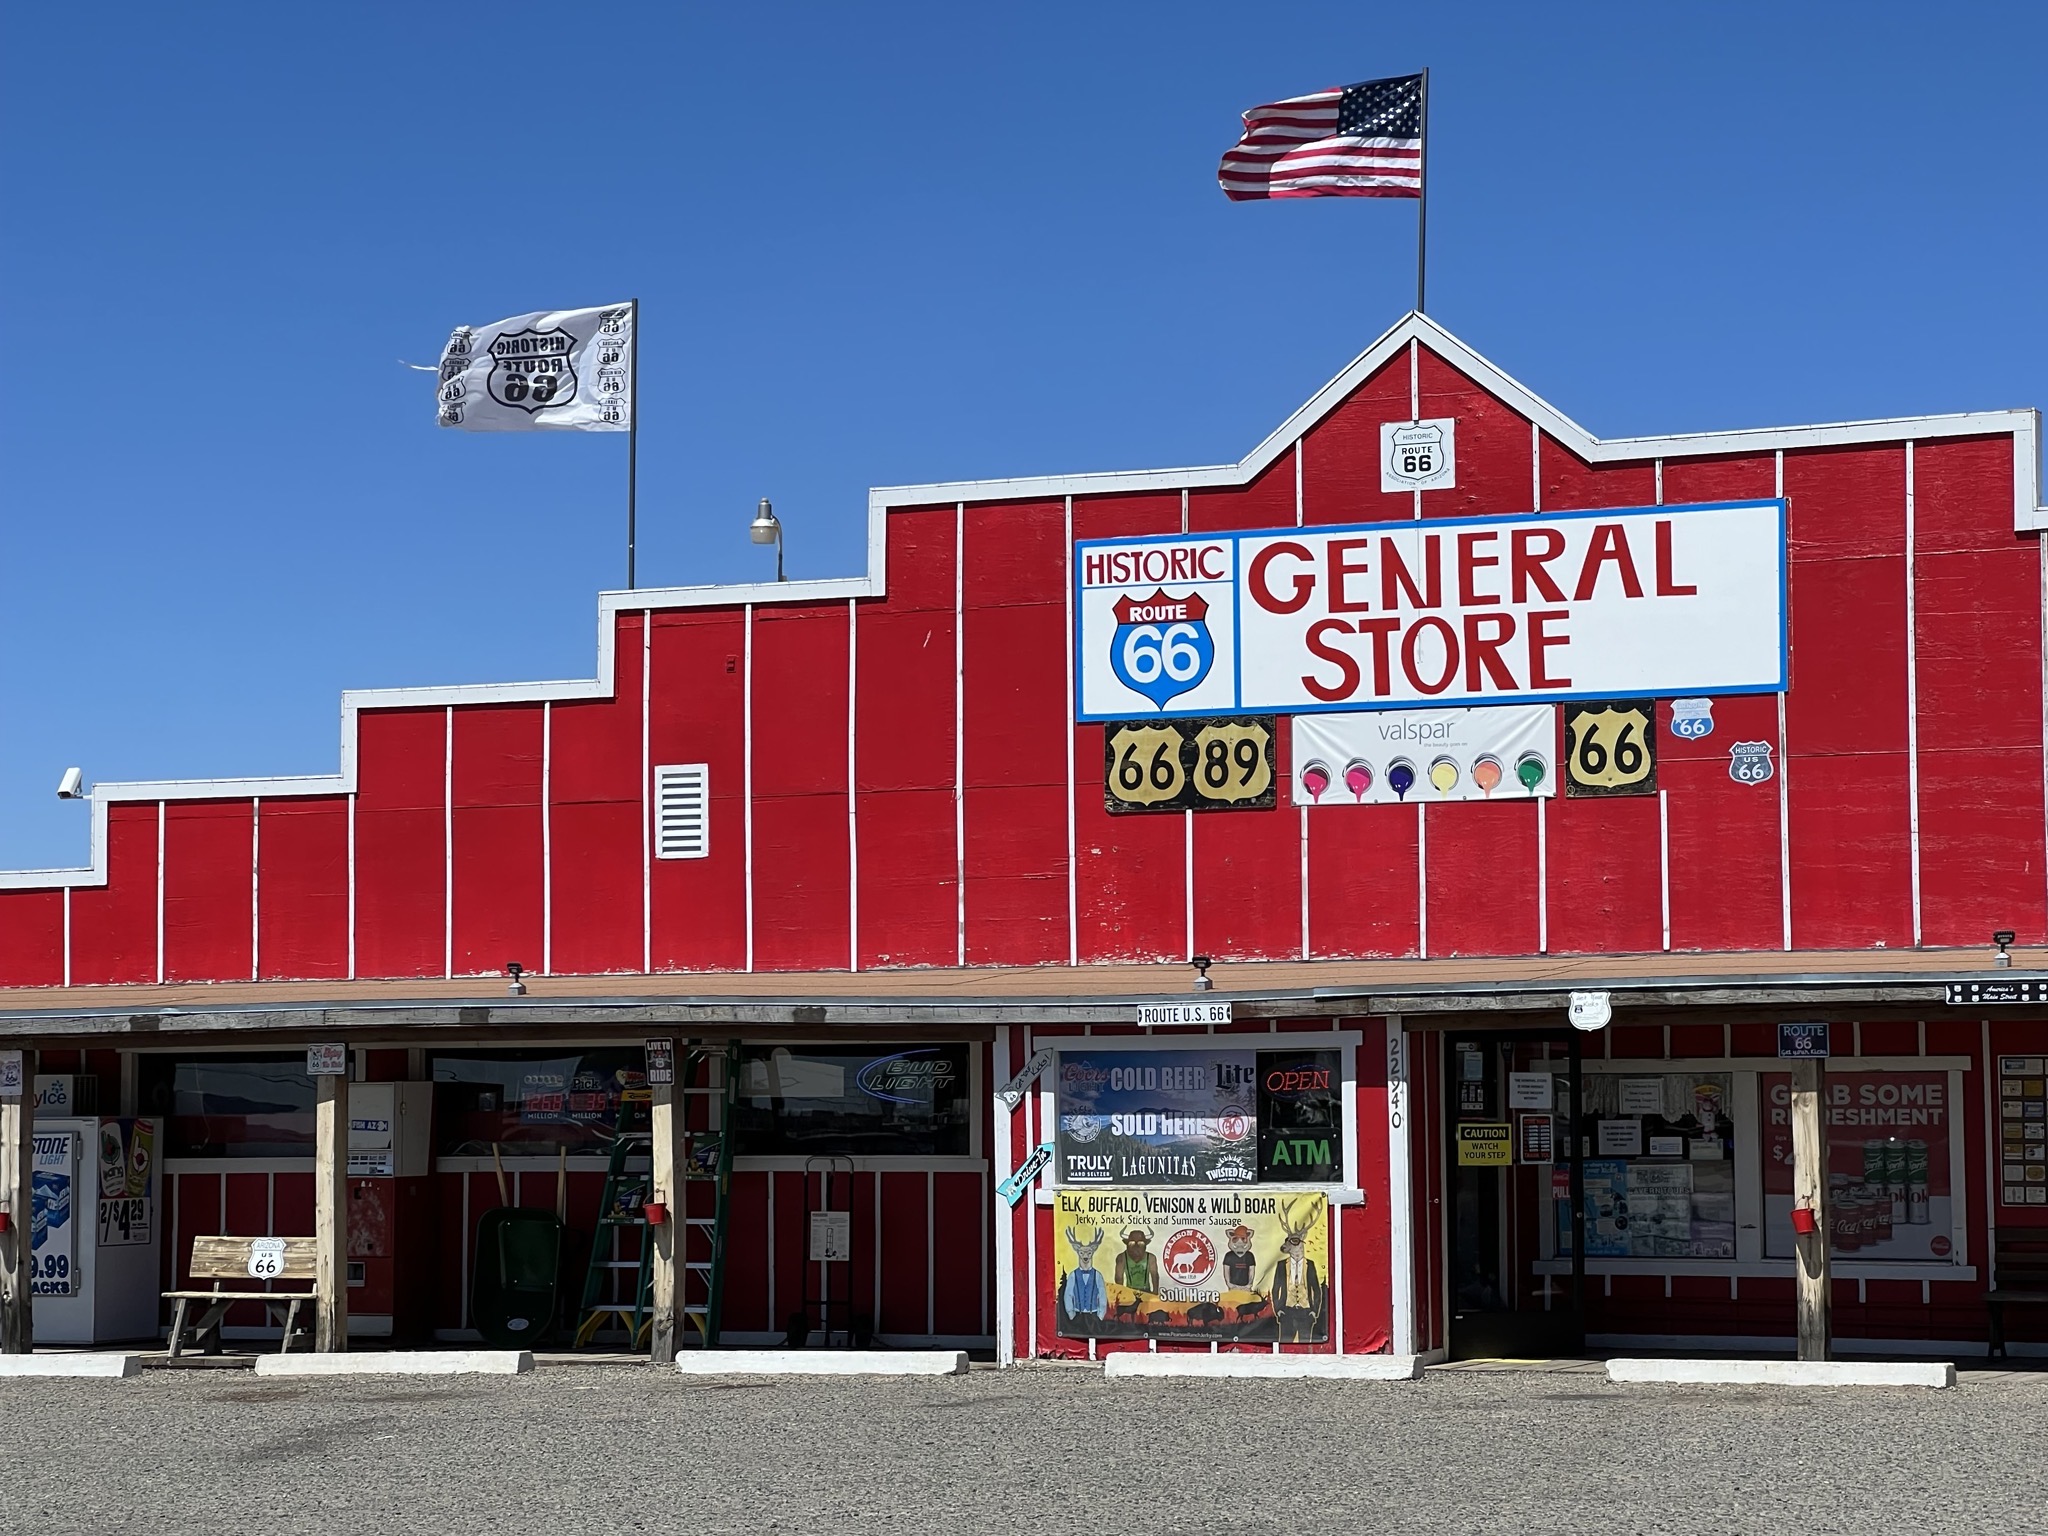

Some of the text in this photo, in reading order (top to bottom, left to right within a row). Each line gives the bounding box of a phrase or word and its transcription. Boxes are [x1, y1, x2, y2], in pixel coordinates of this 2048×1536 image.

[1402, 432, 1433, 440] HISTORIC
[1401, 446, 1433, 455] ROUTE
[1403, 455, 1432, 473] 66
[1086, 545, 1226, 585] HISTORIC
[1247, 520, 1698, 615] GENERAL
[1129, 603, 1188, 622] ROUTE
[1123, 622, 1200, 684] 66
[1300, 610, 1573, 701] STORE
[1378, 717, 1456, 745] valspar
[1680, 719, 1706, 735] 66
[1579, 722, 1643, 775] 66
[1735, 745, 1767, 754] HISTORIC
[1118, 741, 1175, 790] 66
[1204, 738, 1259, 788] 89
[1738, 763, 1765, 780] 66
[1144, 1006, 1224, 1023] ROUTE U.S. 66
[1783, 1025, 1825, 1037] ROUTE
[647, 1041, 671, 1051] LIVE TO
[1795, 1037, 1812, 1050] 66
[650, 1069, 672, 1082] RIDE
[886, 1060, 953, 1075] BUD
[1063, 1063, 1109, 1082] Coors
[571, 1079, 600, 1090] Pick
[868, 1075, 956, 1091] LIGHT
[1110, 1066, 1206, 1091] COLD BEER
[1211, 1063, 1255, 1090] Lite
[1266, 1070, 1331, 1092] OPEN
[1068, 1082, 1105, 1093] LIGHT
[1770, 1084, 1943, 1106] GB SOME
[1110, 1112, 1157, 1137] SOLD
[1161, 1111, 1207, 1137] HERE
[1771, 1107, 1944, 1126] RESHMENT
[1463, 1128, 1507, 1139] CAUTION
[1271, 1139, 1332, 1166] ATM
[1471, 1142, 1499, 1150] WATCH
[39, 1154, 66, 1166] LIGHT
[1067, 1155, 1113, 1170] TRULY
[1464, 1151, 1506, 1159] YOUR STEP
[1018, 1150, 1048, 1184] Drive-In
[1122, 1155, 1197, 1177] LAGUNITAS
[1205, 1166, 1253, 1181] TWISTED TEA
[1552, 1185, 1570, 1199] PULL
[1061, 1196, 1276, 1215] ELK, BUFFALO, VENISON & WILD BOAR
[1075, 1215, 1242, 1228] Jerky, Snack Sticks and Summer Sausage
[1164, 1229, 1215, 1261] PEARSON RANCH
[255, 1259, 276, 1274] 66
[31, 1281, 70, 1294] ACKS
[1160, 1286, 1220, 1304] Sold Here
